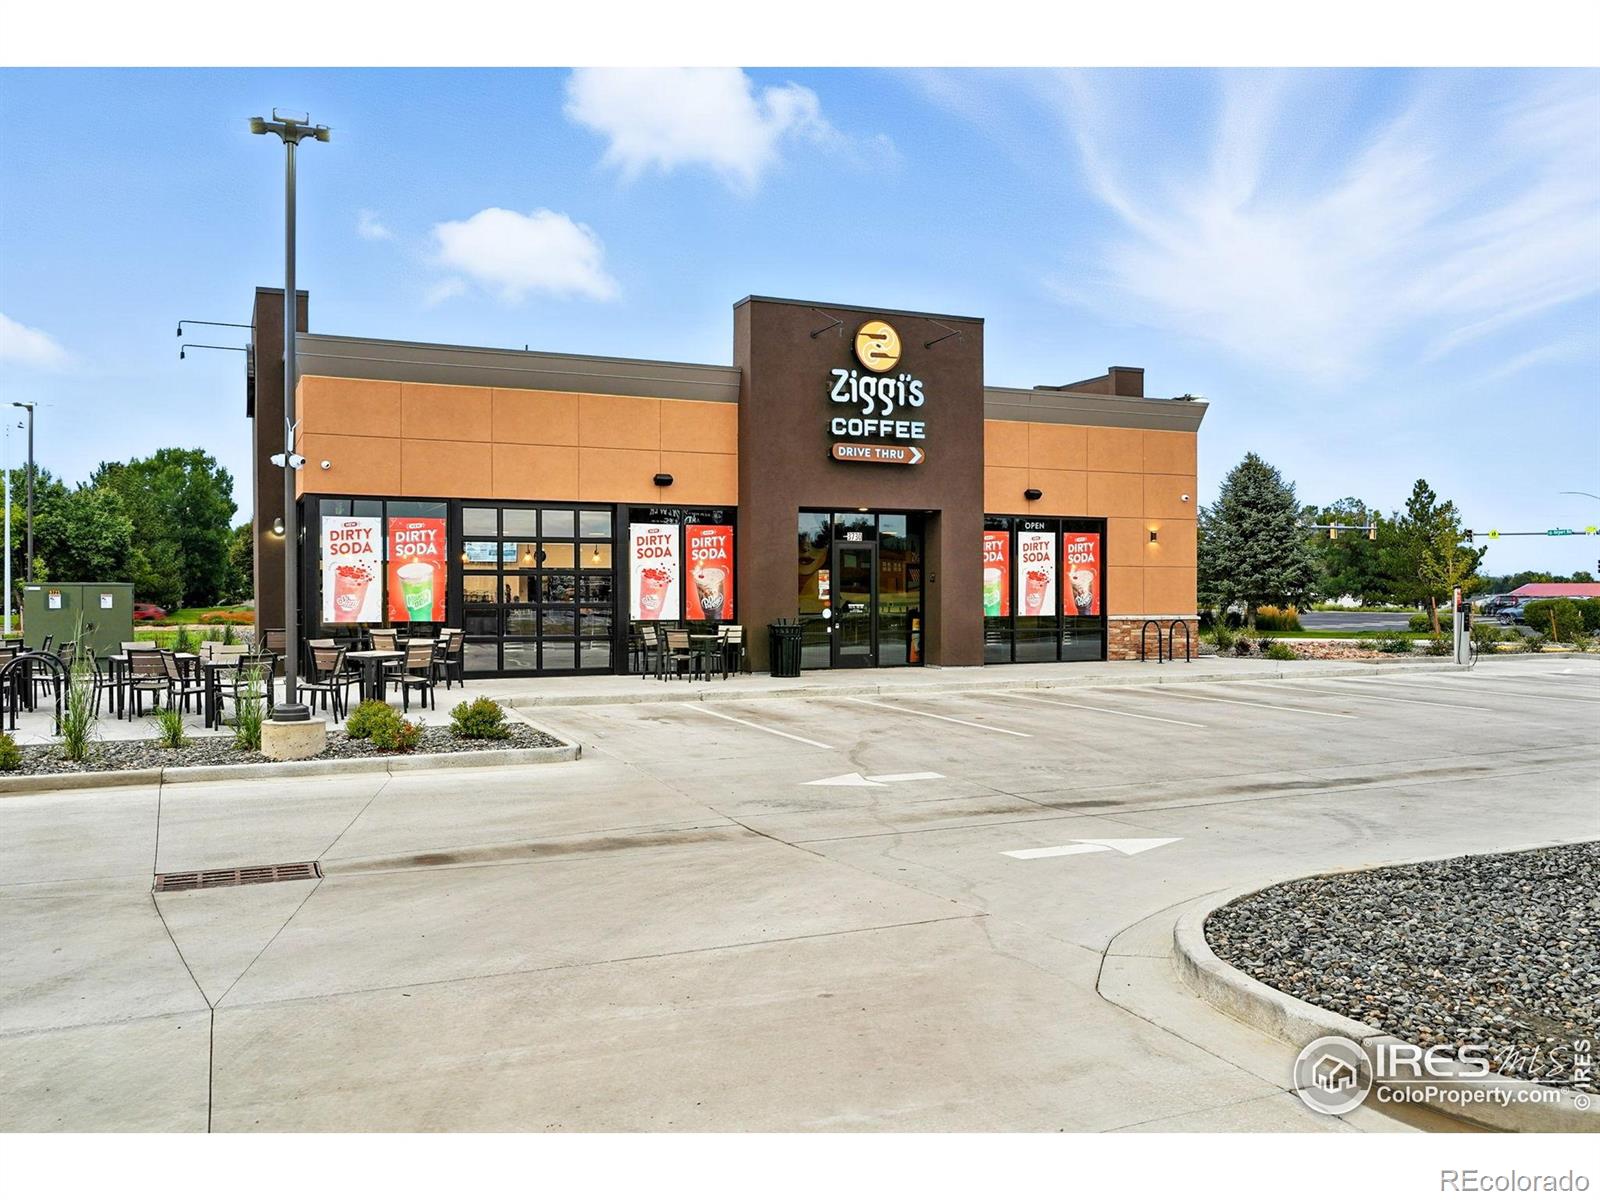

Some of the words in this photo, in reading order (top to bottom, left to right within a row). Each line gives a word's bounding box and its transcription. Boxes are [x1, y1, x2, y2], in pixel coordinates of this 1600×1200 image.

[831, 368, 925, 416] Ziggi's
[831, 417, 926, 439] COFFEE
[838, 446, 871, 457] DRIVE
[875, 448, 904, 459] THRU
[1024, 522, 1045, 530] OPEN
[330, 528, 372, 541] DIRTY
[395, 530, 437, 542] DIRTY
[637, 534, 671, 546] DIRTY
[330, 541, 373, 555] SODA
[691, 536, 726, 548] DIRTY
[983, 540, 1004, 551] RTY
[1022, 541, 1050, 552] DIRTY
[1067, 543, 1094, 553] DIRTY
[395, 543, 437, 556] SODA
[637, 547, 672, 559] SODA
[691, 548, 727, 560] SODA
[983, 551, 1004, 562] ODA
[1022, 552, 1051, 563] SODA
[1067, 553, 1095, 564] SODA
